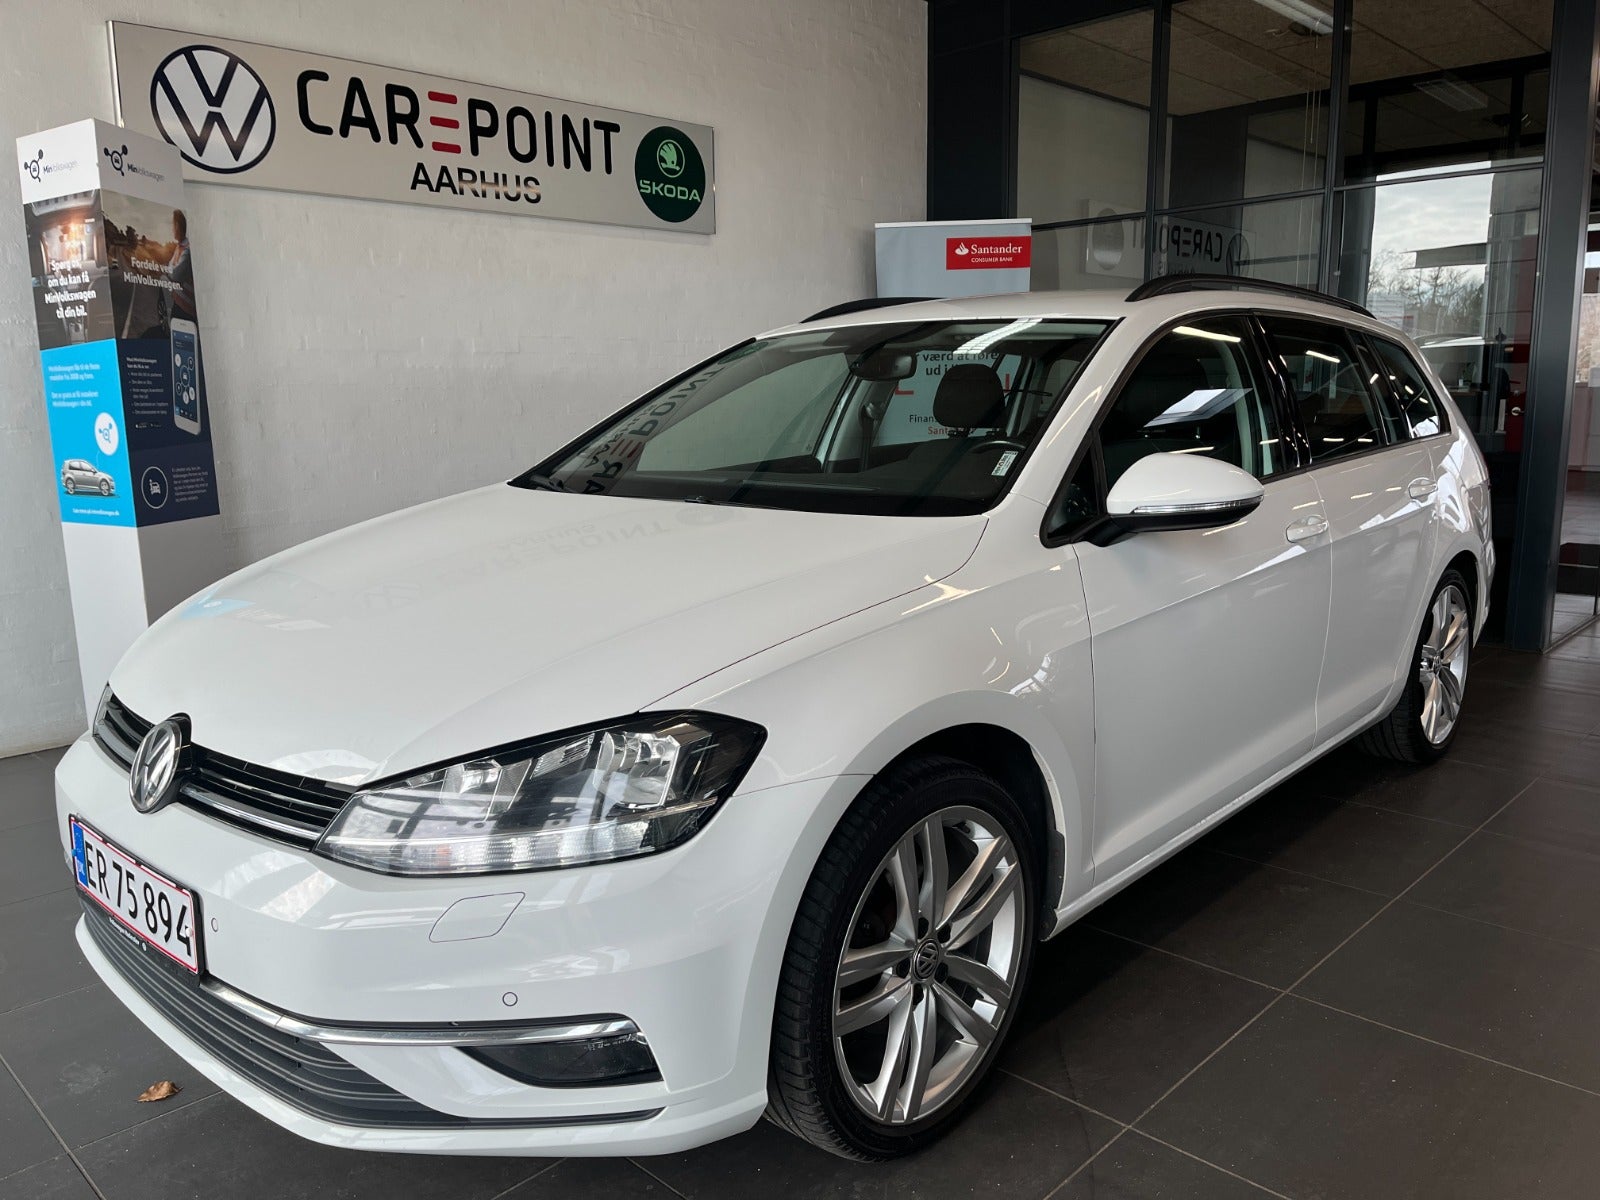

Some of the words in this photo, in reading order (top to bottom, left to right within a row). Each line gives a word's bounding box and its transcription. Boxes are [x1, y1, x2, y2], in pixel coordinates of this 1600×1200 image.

[296, 69, 621, 175] CAREPOINT
[410, 162, 542, 204] AARHUS
[970, 242, 1023, 255] Santander
[131, 256, 159, 272] Fordele
[48, 279, 59, 287] om
[60, 275, 68, 286] du
[68, 273, 81, 284] kan
[123, 271, 183, 292] MinVolkswagen.
[44, 290, 97, 304] MinVolkswagen
[65, 306, 76, 318] din
[923, 352, 953, 362] værd
[926, 364, 940, 376] ud
[85, 839, 110, 901] ER
[112, 864, 138, 920] 75
[143, 881, 192, 957] 894
